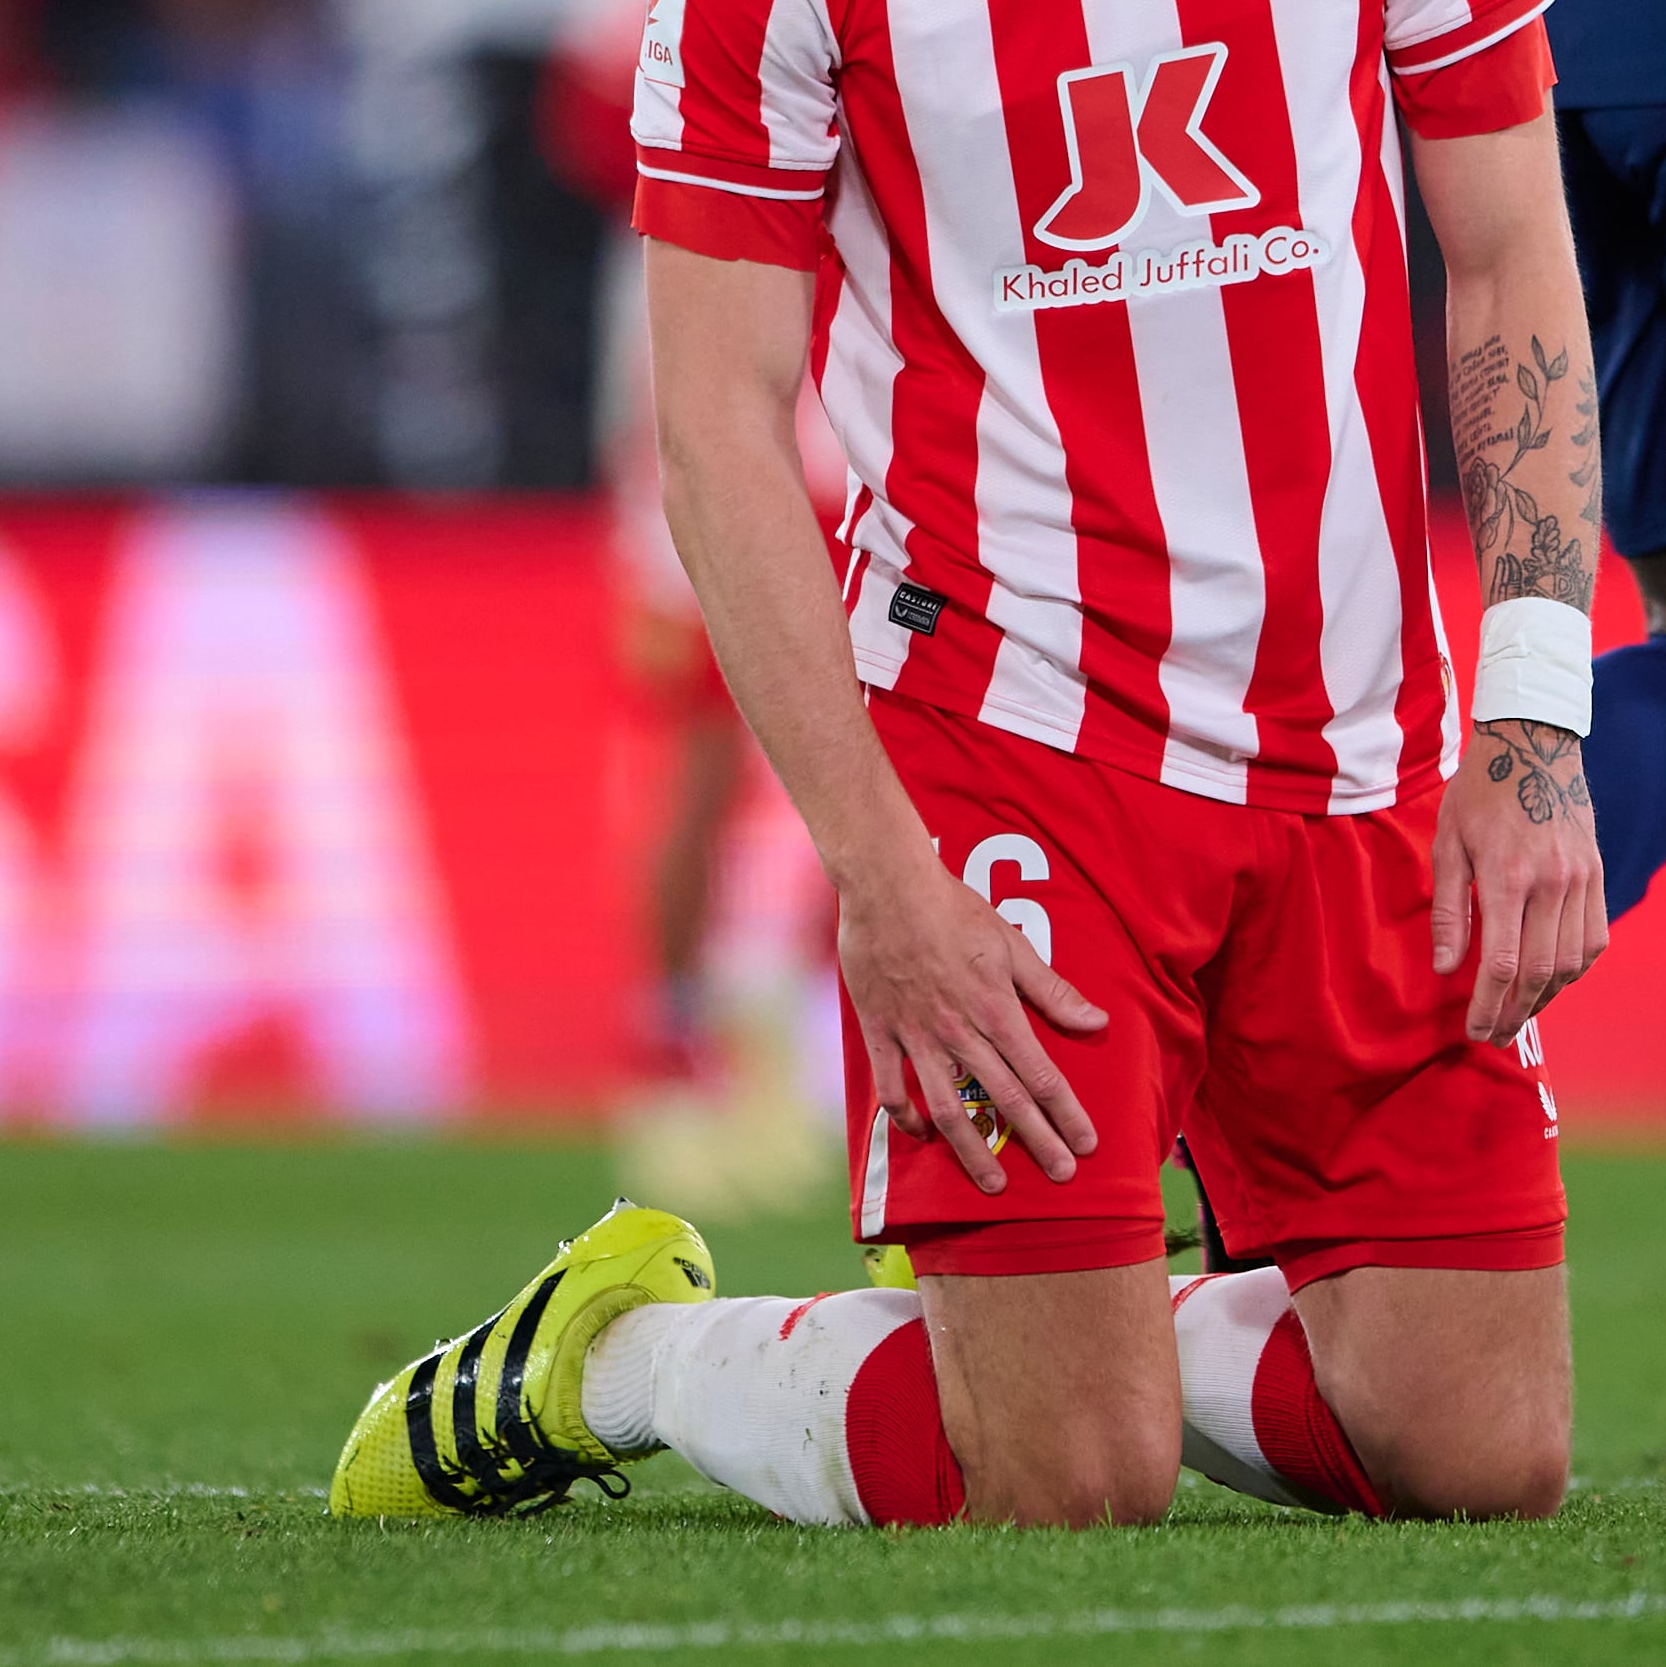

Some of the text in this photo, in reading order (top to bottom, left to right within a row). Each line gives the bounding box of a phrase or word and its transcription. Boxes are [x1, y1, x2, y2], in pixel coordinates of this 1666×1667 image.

[644, 39, 674, 66] IGA
[1042, 50, 1252, 243] JK
[1002, 236, 1320, 302] Khaled Juffali Co.
